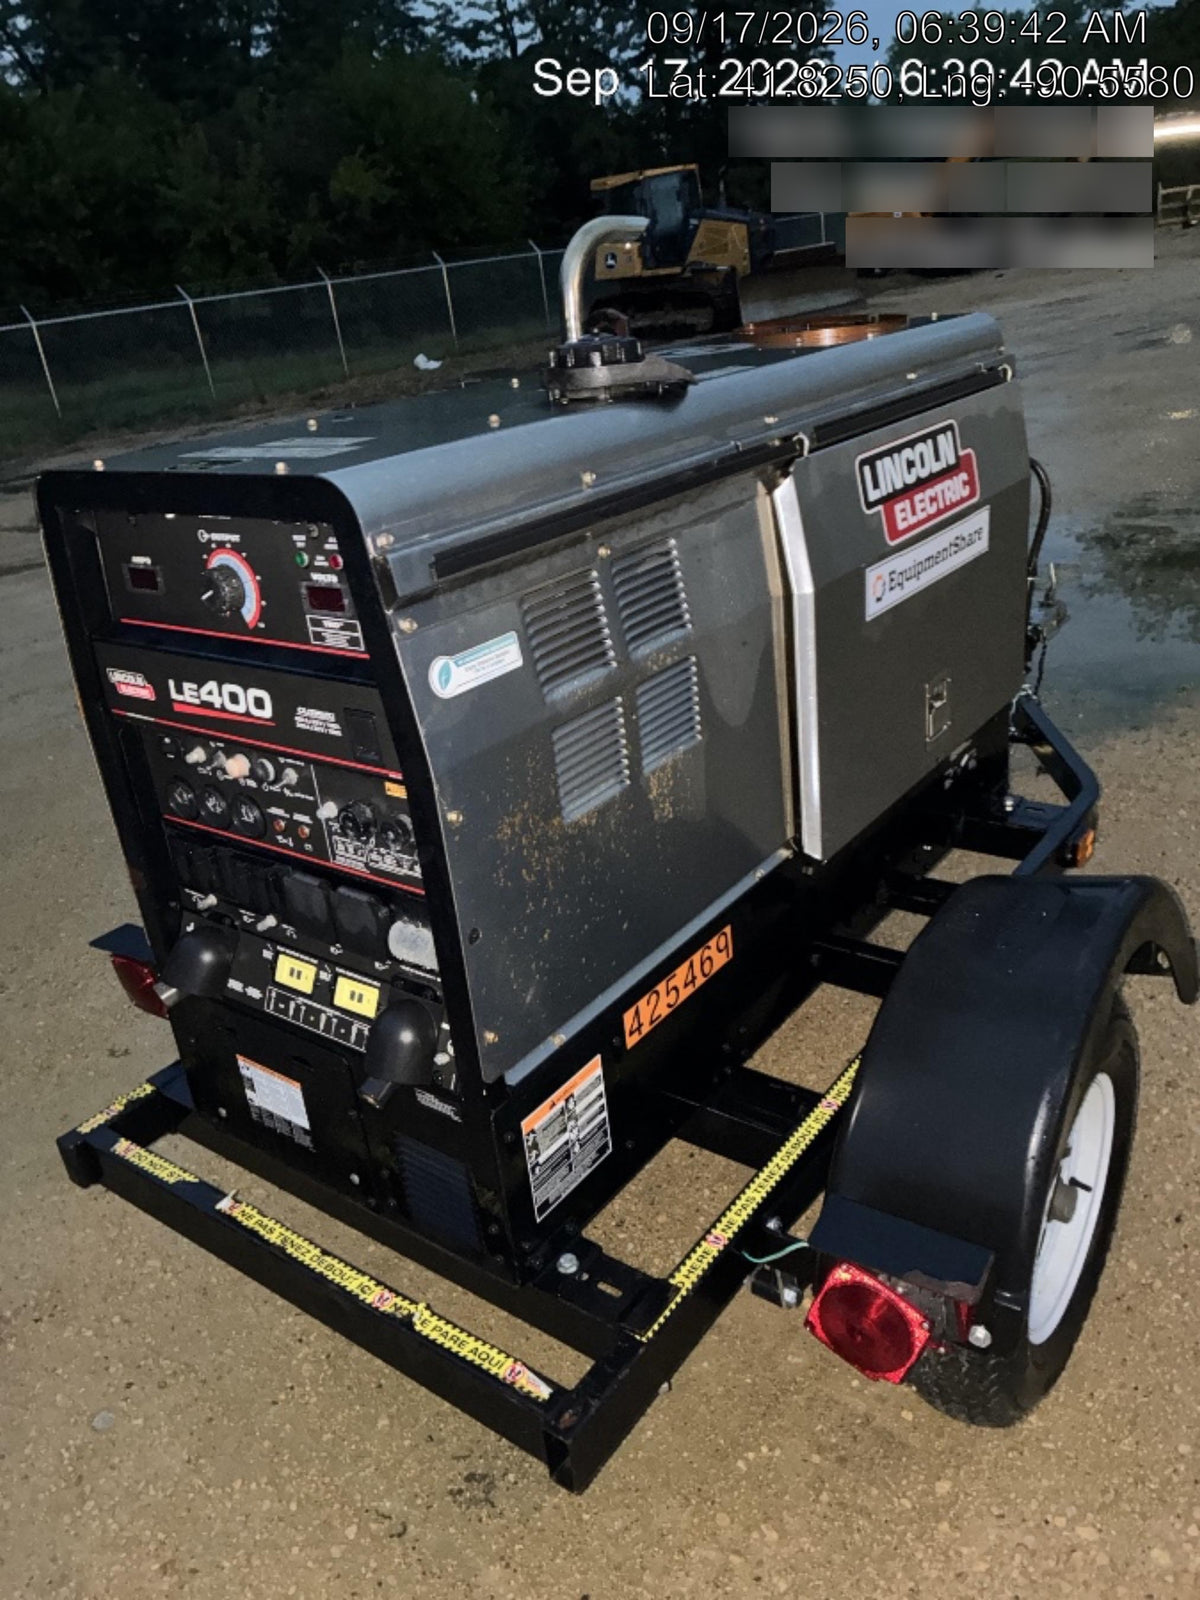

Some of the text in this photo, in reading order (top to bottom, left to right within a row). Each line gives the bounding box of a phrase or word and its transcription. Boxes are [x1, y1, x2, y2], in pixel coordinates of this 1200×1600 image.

[863, 431, 956, 502] LINCOLN
[892, 472, 970, 532] ELECTRIC
[887, 527, 984, 591] EquipmentShare
[168, 676, 274, 720] LE400
[628, 931, 731, 1038] 425469
[237, 1208, 256, 1222] NE
[253, 1218, 278, 1236] PAS
[275, 1230, 312, 1258] TENEZ
[308, 1253, 360, 1285] DEBOUT
[684, 1246, 715, 1279] HERE
[430, 1324, 471, 1350] PARE
